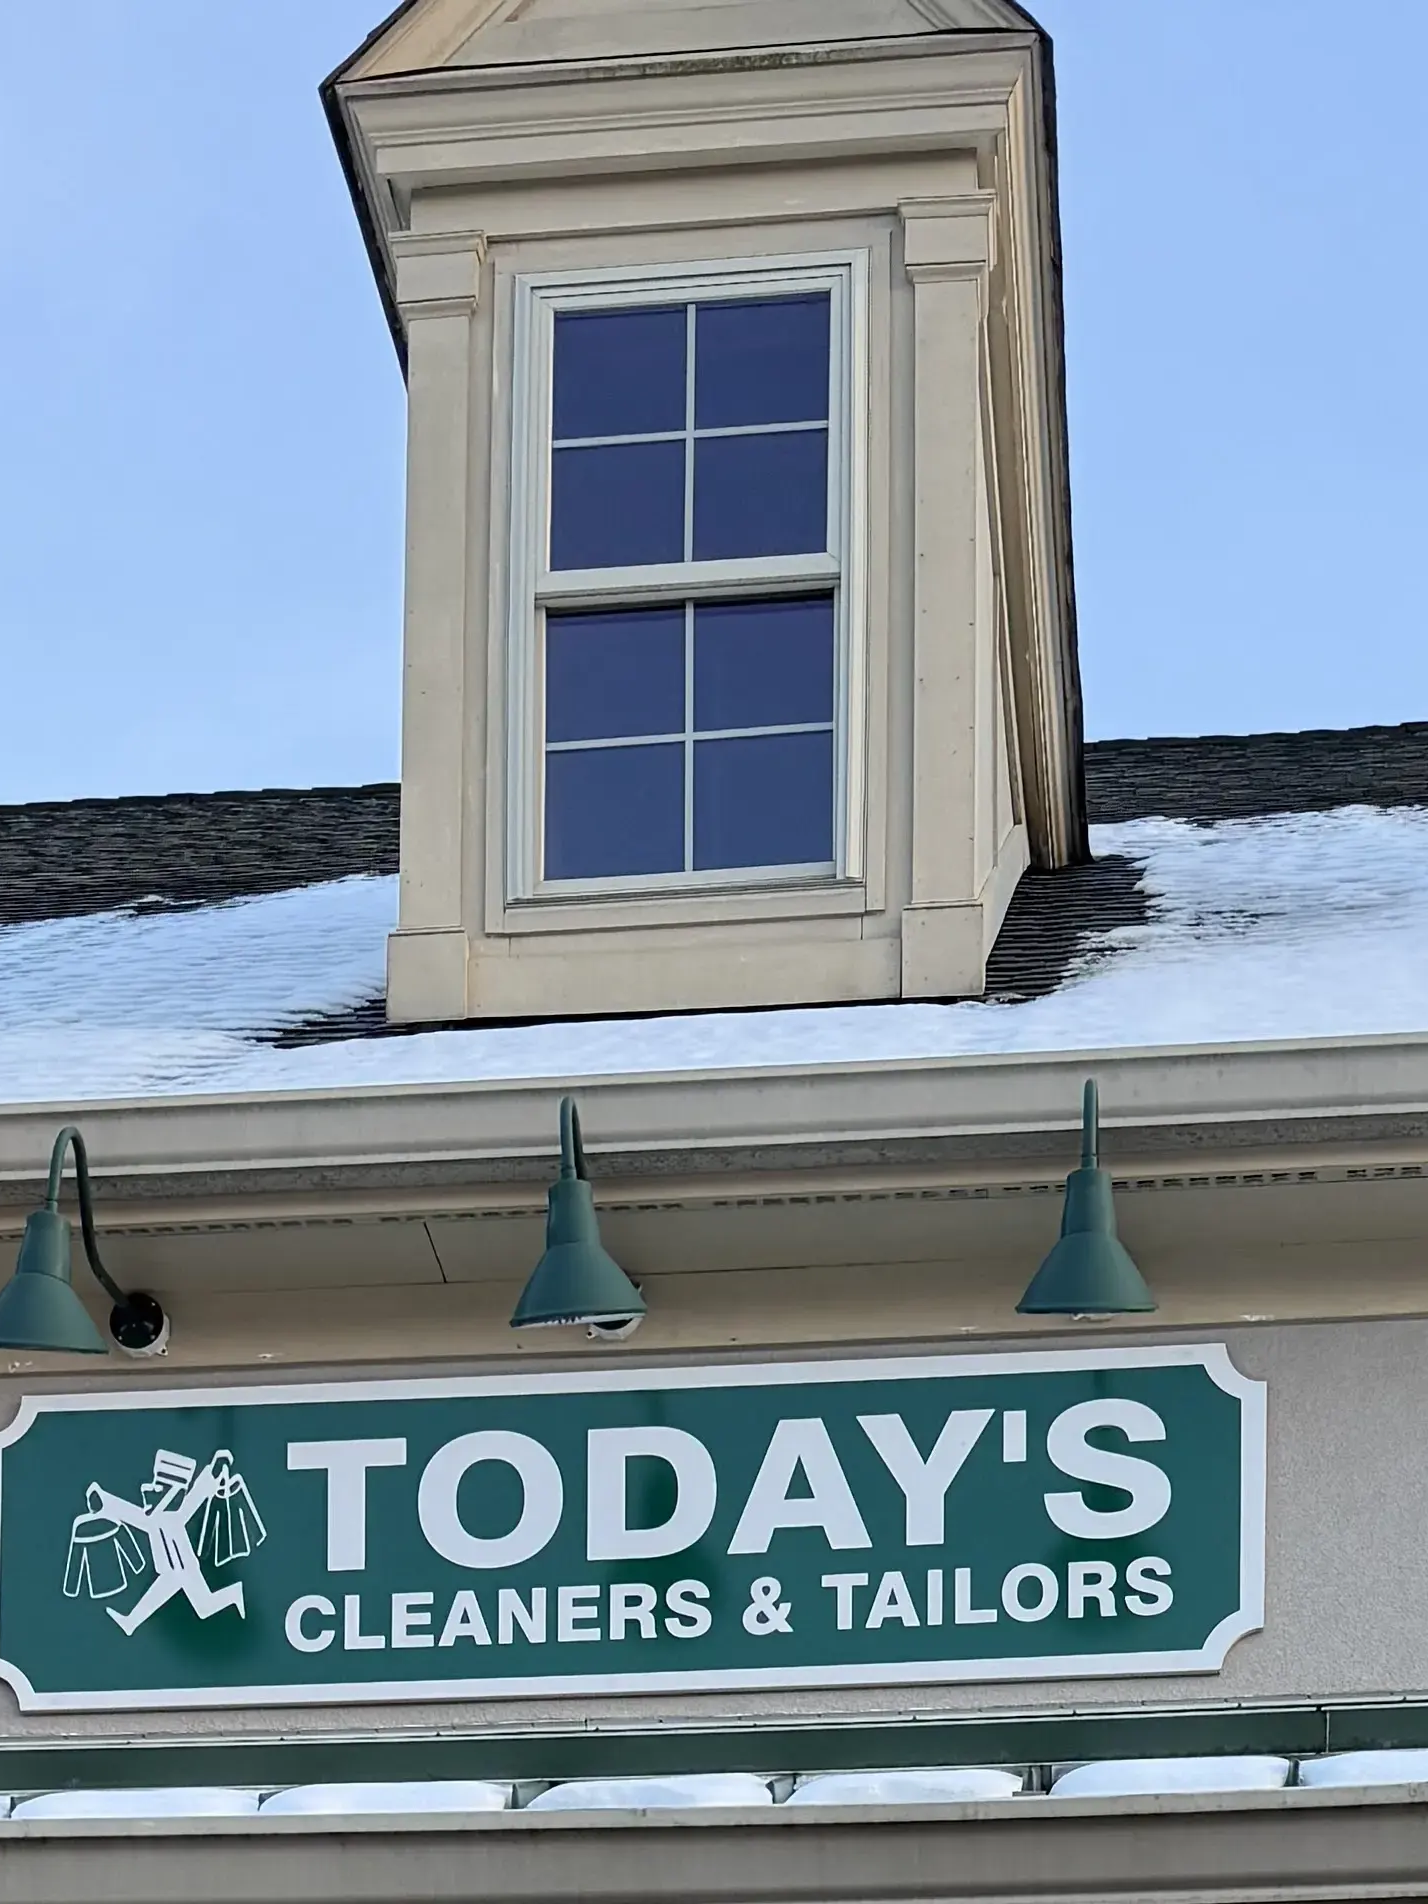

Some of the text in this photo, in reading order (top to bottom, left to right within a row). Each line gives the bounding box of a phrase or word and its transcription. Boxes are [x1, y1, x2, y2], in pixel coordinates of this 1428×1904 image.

[286, 1397, 1172, 1572] TODAY'S
[284, 1556, 1174, 1653] CLEANERS & TAILORS
